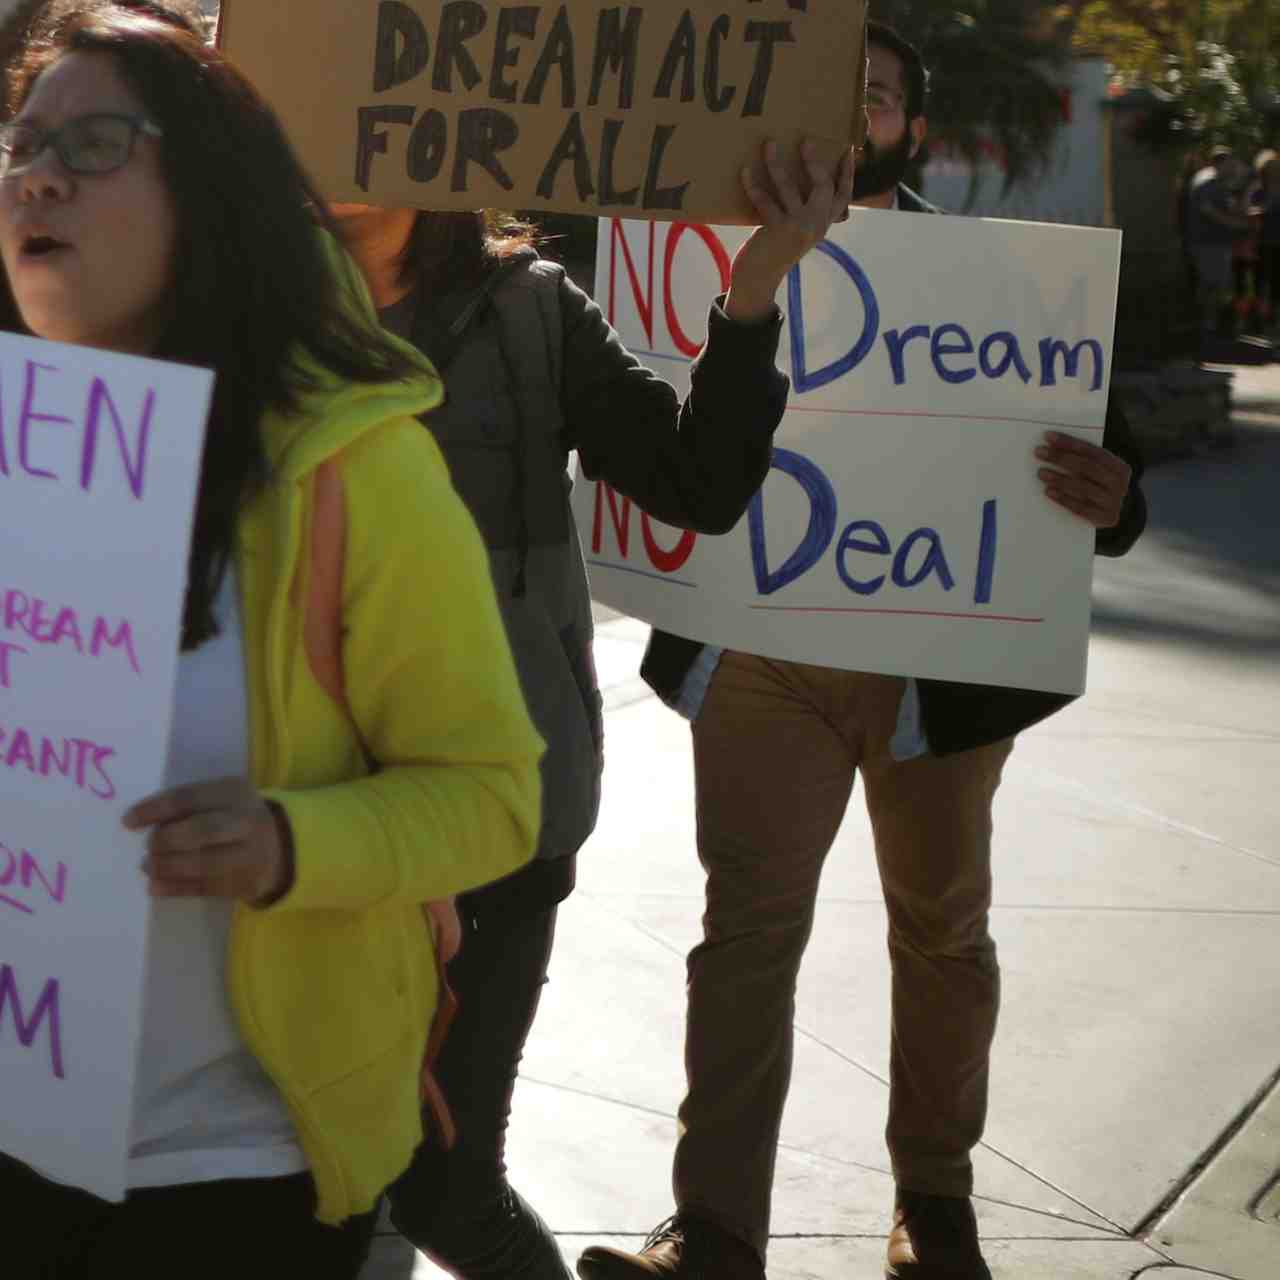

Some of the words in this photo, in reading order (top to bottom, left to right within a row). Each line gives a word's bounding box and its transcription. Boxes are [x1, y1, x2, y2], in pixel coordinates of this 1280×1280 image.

[373, 0, 644, 110] DREAM
[652, 10, 796, 118] ACT
[354, 104, 519, 193] FOR
[535, 111, 690, 210] ALL
[609, 217, 732, 359] NO
[787, 239, 1104, 395] Dream
[749, 447, 997, 604] Deal
